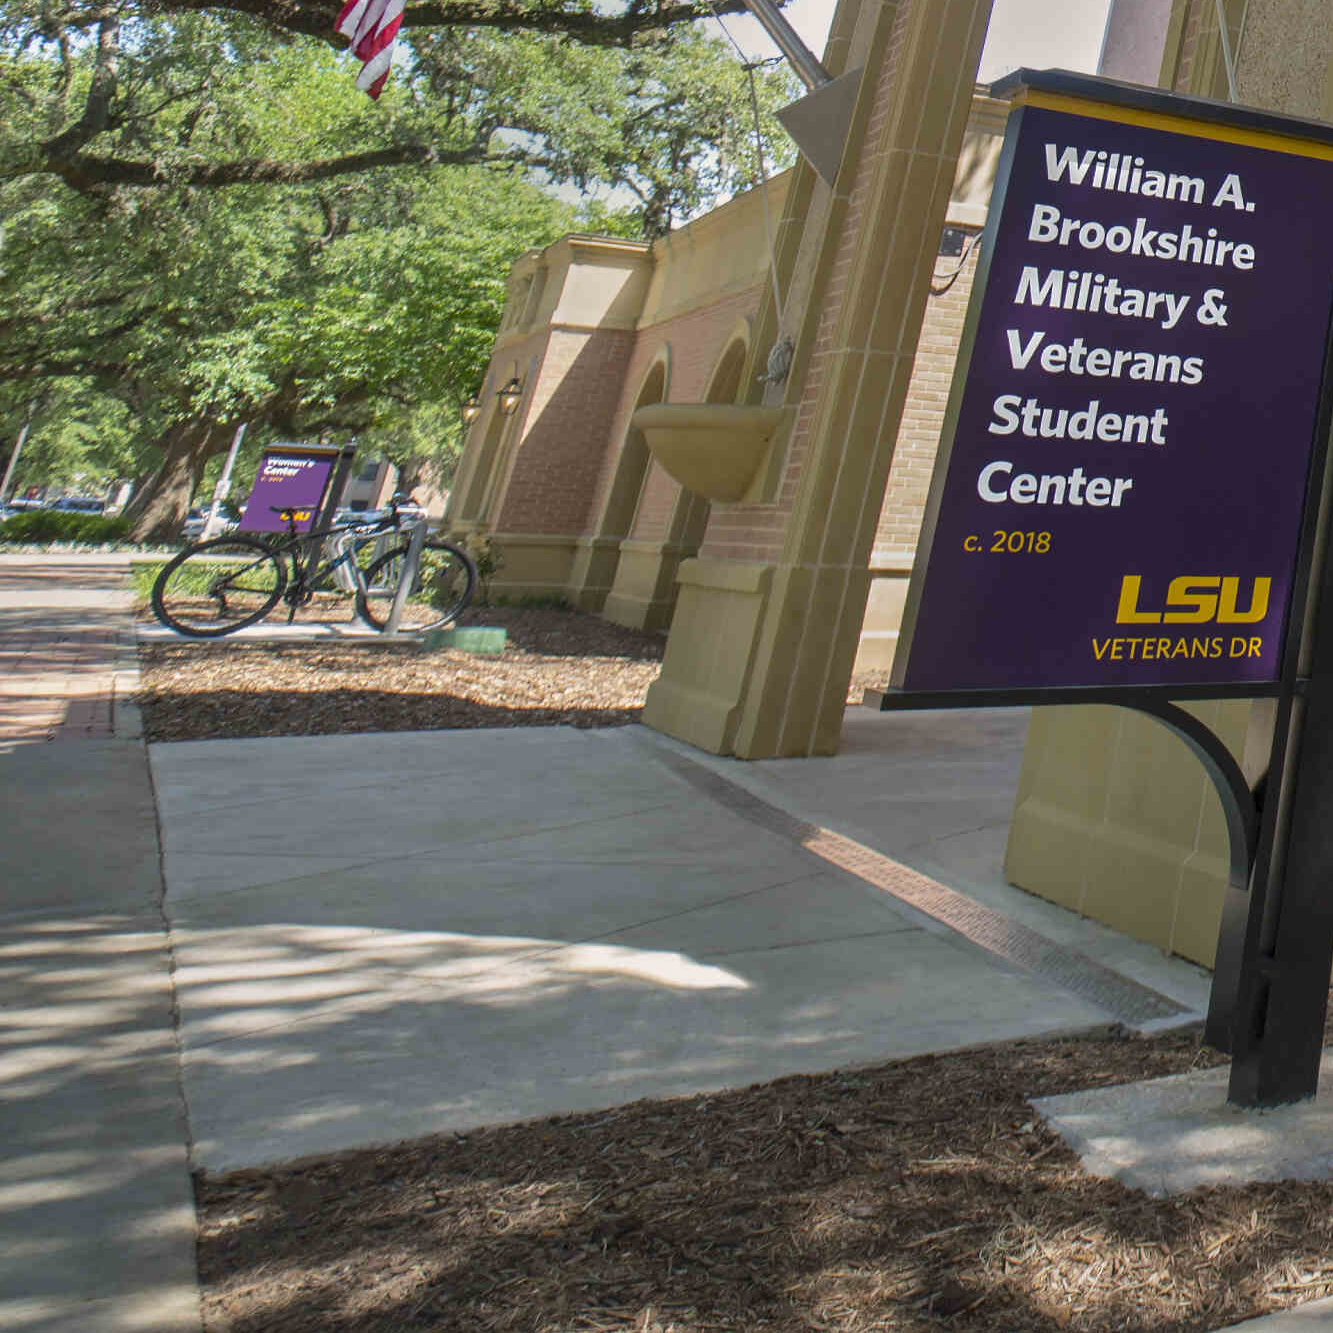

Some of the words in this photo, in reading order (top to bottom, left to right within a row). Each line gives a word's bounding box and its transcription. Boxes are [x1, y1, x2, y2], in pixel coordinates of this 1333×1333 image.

[1044, 143, 1205, 205] William
[1212, 173, 1257, 212] A.
[1028, 203, 1256, 270] Brookshire
[1014, 265, 1191, 330] Military
[1196, 288, 1229, 327] &
[1006, 329, 1204, 385] Veterans
[988, 394, 1169, 445] Student
[976, 460, 1133, 507] Center
[963, 535, 984, 553] c.
[990, 530, 1052, 553] 2018
[1115, 575, 1272, 624] LSU
[1091, 636, 1225, 661] VETERANS
[1229, 636, 1263, 659] DR
